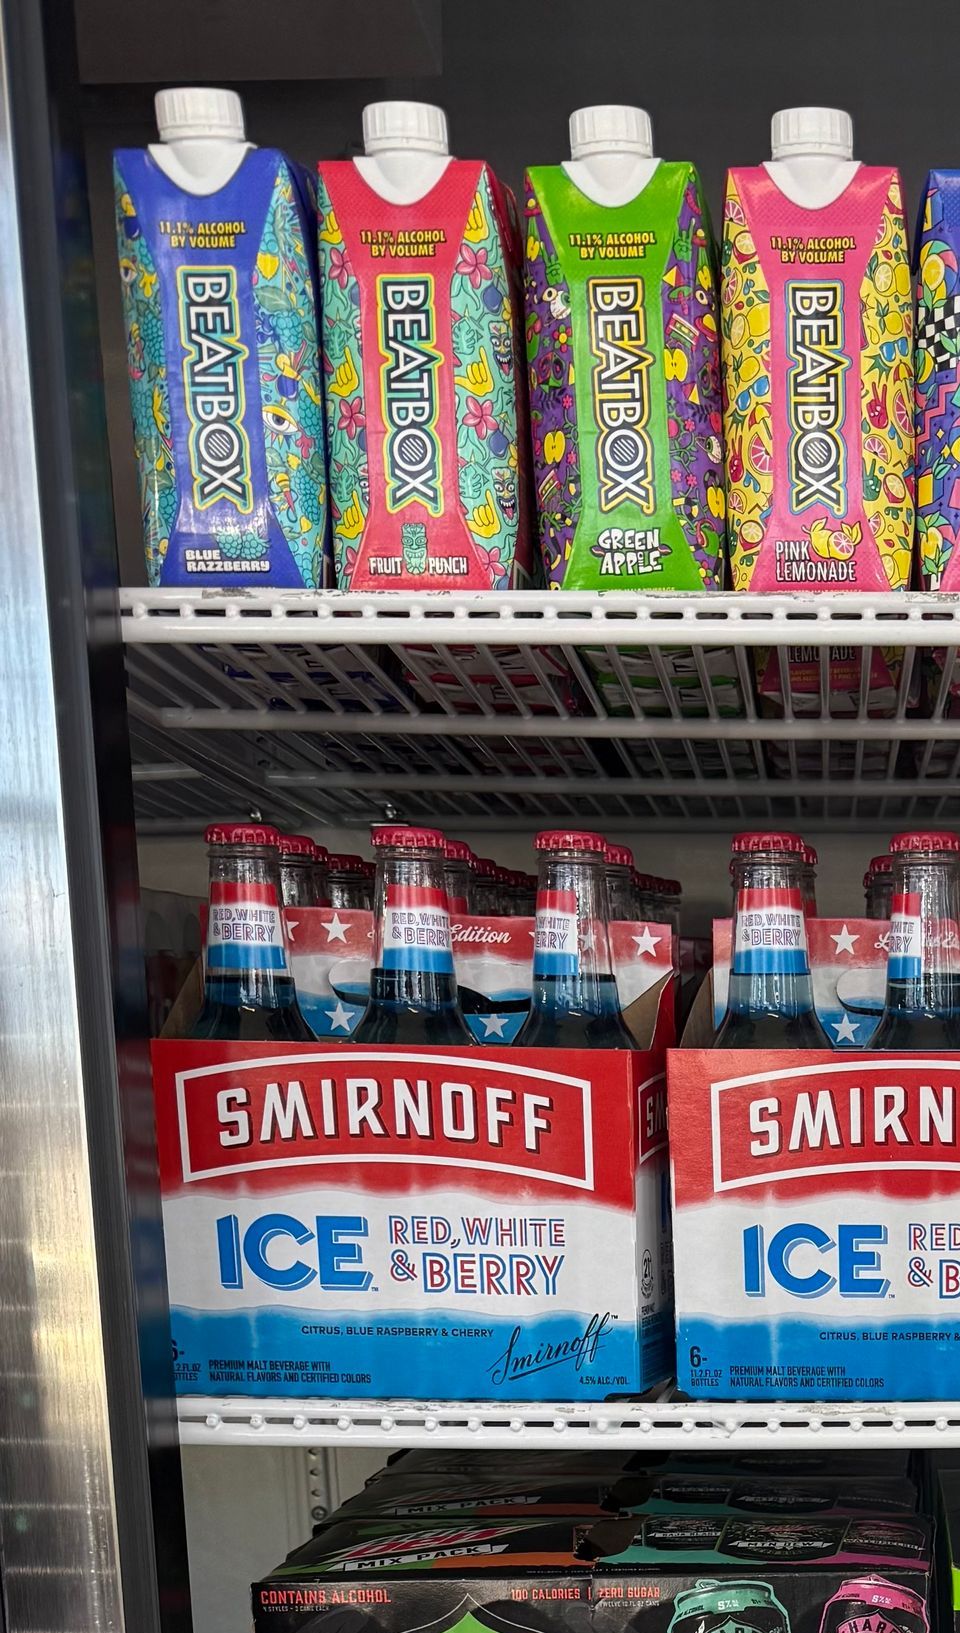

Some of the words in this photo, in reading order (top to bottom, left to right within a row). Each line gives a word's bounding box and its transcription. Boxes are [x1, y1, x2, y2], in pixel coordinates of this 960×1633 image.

[159, 222, 194, 234] 11.1%
[197, 221, 246, 234] ALCOHOL
[171, 235, 185, 248] BY
[190, 234, 236, 248] VOLUME
[360, 231, 394, 244] 11.1%
[398, 230, 446, 244] ALCOHOL
[568, 233, 603, 246] 11.1%
[606, 232, 656, 245] ALCOHOL
[770, 237, 805, 250] 11.1%
[806, 236, 856, 250] ALCOHOL
[371, 245, 386, 258] BY
[389, 244, 436, 257] VOLUME
[580, 246, 595, 259] BY
[598, 245, 645, 259] VOLUME
[780, 250, 795, 264] BY
[798, 250, 846, 264] VOLUME
[183, 272, 246, 497] BEATBOX
[384, 281, 439, 501] BEATBOX
[594, 283, 650, 507] BEATBOX
[793, 288, 845, 509] BEATBOX
[597, 527, 661, 550] GREEN
[185, 549, 221, 561] BLUE
[775, 540, 810, 562] PINK
[186, 560, 271, 572] RAZZBERRY
[368, 557, 402, 575] FRUIT
[428, 556, 468, 574] PUNCH
[600, 550, 663, 576] APPLE
[775, 560, 856, 582] LEMONADE
[217, 1079, 551, 1152] SMIRNOFF
[217, 1214, 373, 1291] ICE
[743, 1223, 890, 1299] ICE
[391, 1250, 418, 1281] &
[423, 1253, 565, 1296] BERRY
[907, 1257, 932, 1288] &
[487, 1312, 614, 1386] Smirnoff
[729, 1366, 764, 1376] PREMIUM
[766, 1366, 785, 1376] MALT
[787, 1366, 826, 1376] BEVERAGE
[827, 1366, 846, 1376] WITH
[730, 1377, 764, 1387] NATURAL
[765, 1377, 798, 1388] FLAVORS
[800, 1377, 815, 1388] AND
[817, 1377, 854, 1388] CERTIFIED
[855, 1378, 885, 1388] COLORS
[260, 1589, 327, 1605] CONTAINS
[332, 1589, 392, 1604] ALCOHOL
[510, 1588, 529, 1601] 100
[531, 1588, 581, 1601] CALORIES
[599, 1587, 624, 1599] ZERO
[627, 1586, 661, 1599] SUGAR
